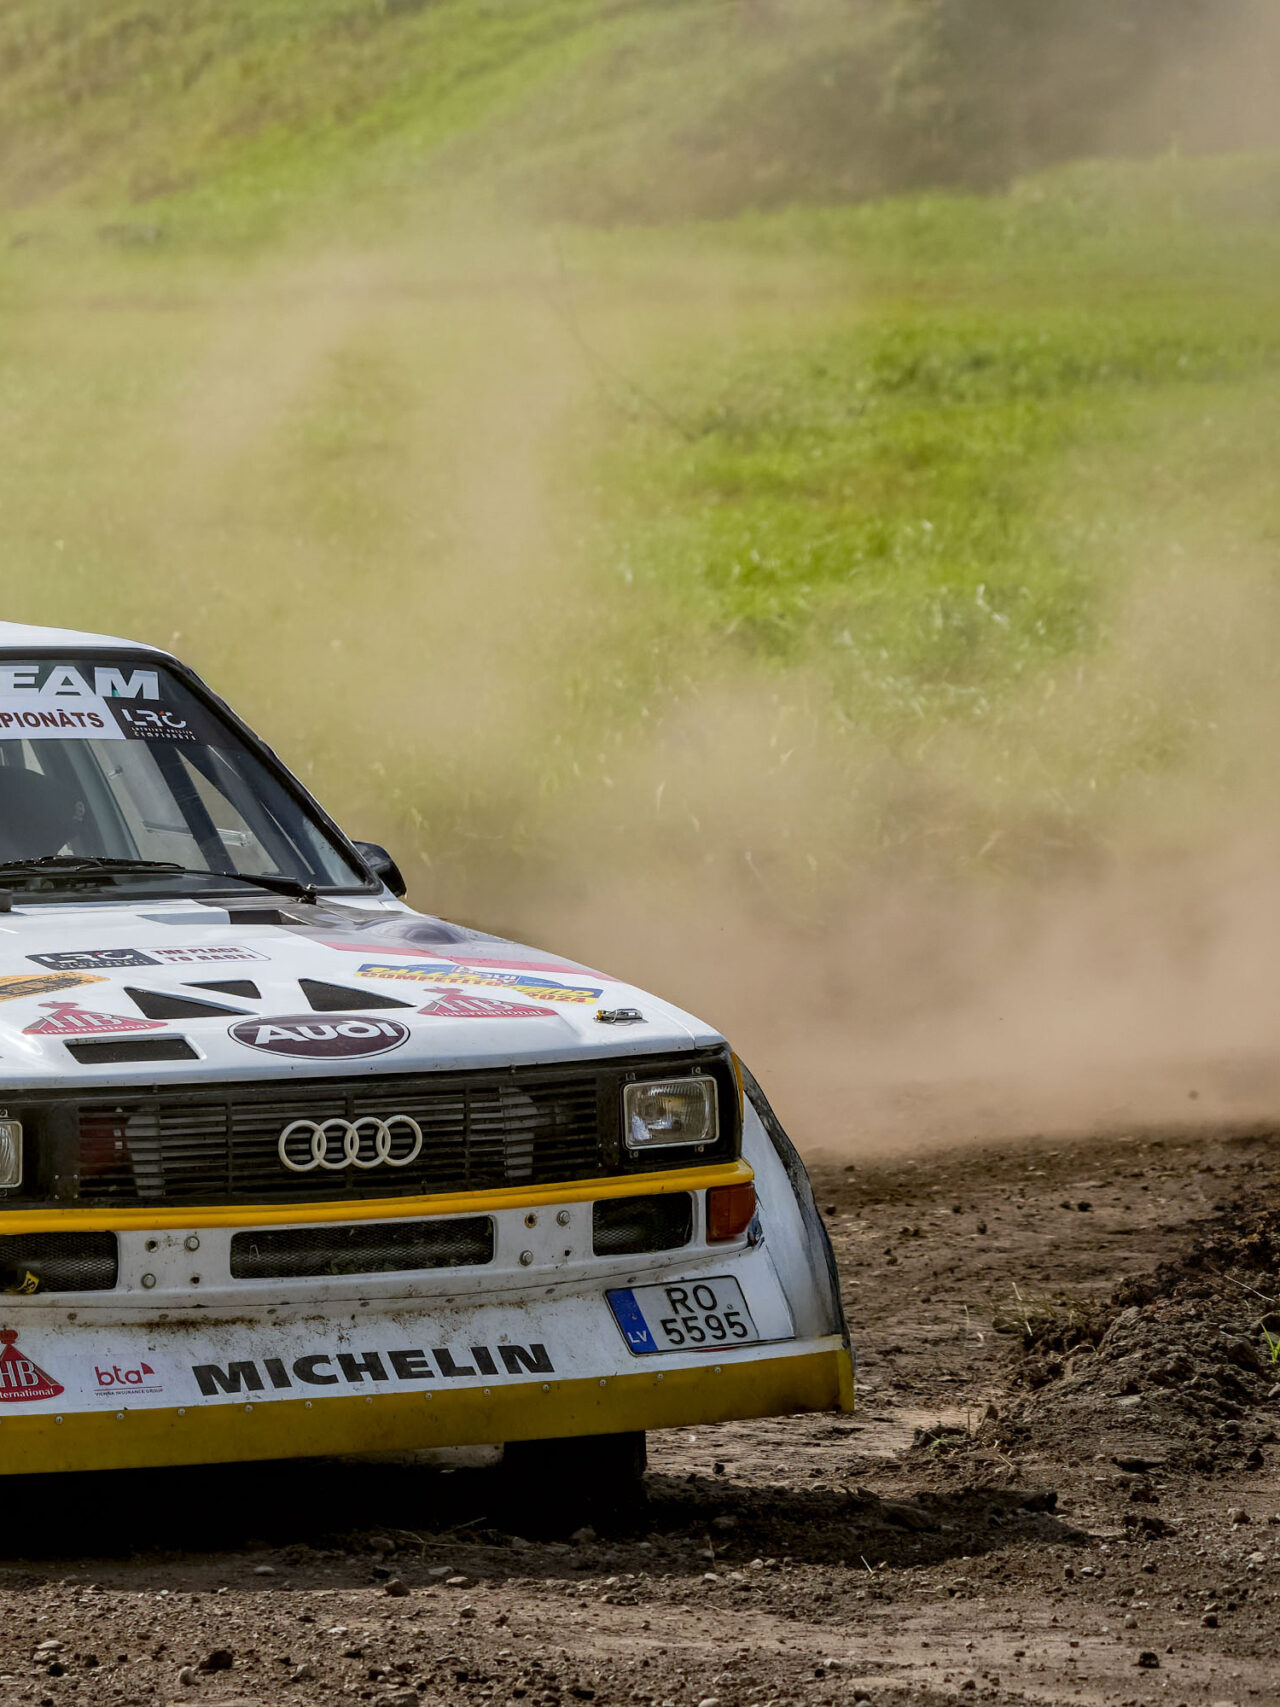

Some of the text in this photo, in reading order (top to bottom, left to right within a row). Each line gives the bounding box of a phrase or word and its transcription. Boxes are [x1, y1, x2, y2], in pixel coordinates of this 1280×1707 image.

[121, 709, 187, 728] LRC
[39, 951, 134, 963] LRC
[41, 1014, 123, 1028] HB
[665, 1284, 718, 1314] RO
[627, 1330, 648, 1344] LV
[660, 1312, 748, 1345] 5595
[94, 1365, 144, 1386] bta
[191, 1343, 555, 1396] MICHELIN
